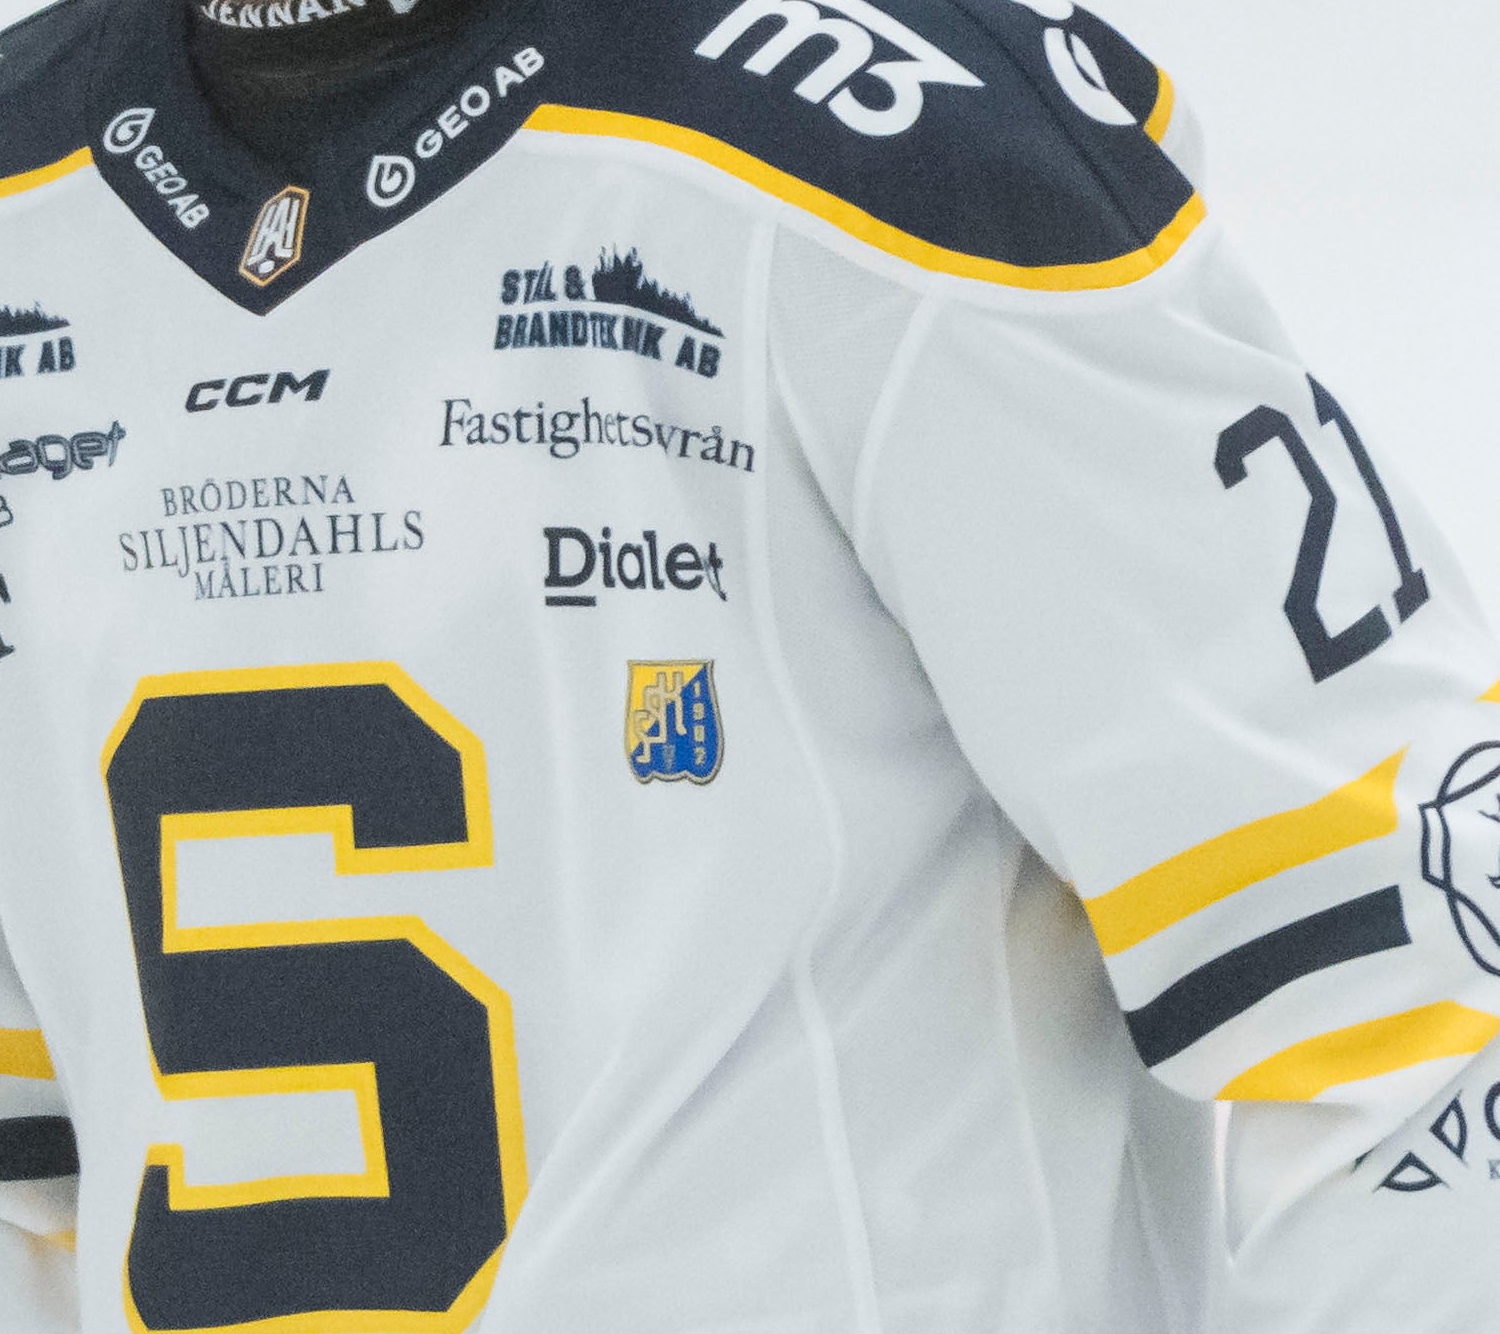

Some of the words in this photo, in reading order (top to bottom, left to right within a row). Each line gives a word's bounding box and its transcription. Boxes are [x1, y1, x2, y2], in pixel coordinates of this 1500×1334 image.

[414, 84, 491, 160] GEO
[494, 46, 545, 98] AB
[134, 144, 188, 196] GEO
[166, 192, 211, 230] AB
[36, 335, 77, 375] AB
[675, 334, 722, 379] AB
[184, 368, 331, 414] CCM
[160, 474, 357, 517] BRÖDERNA
[118, 509, 426, 579] SILJENDAHLS
[1213, 372, 1431, 685] 21
[193, 561, 326, 601] MÅLERI
